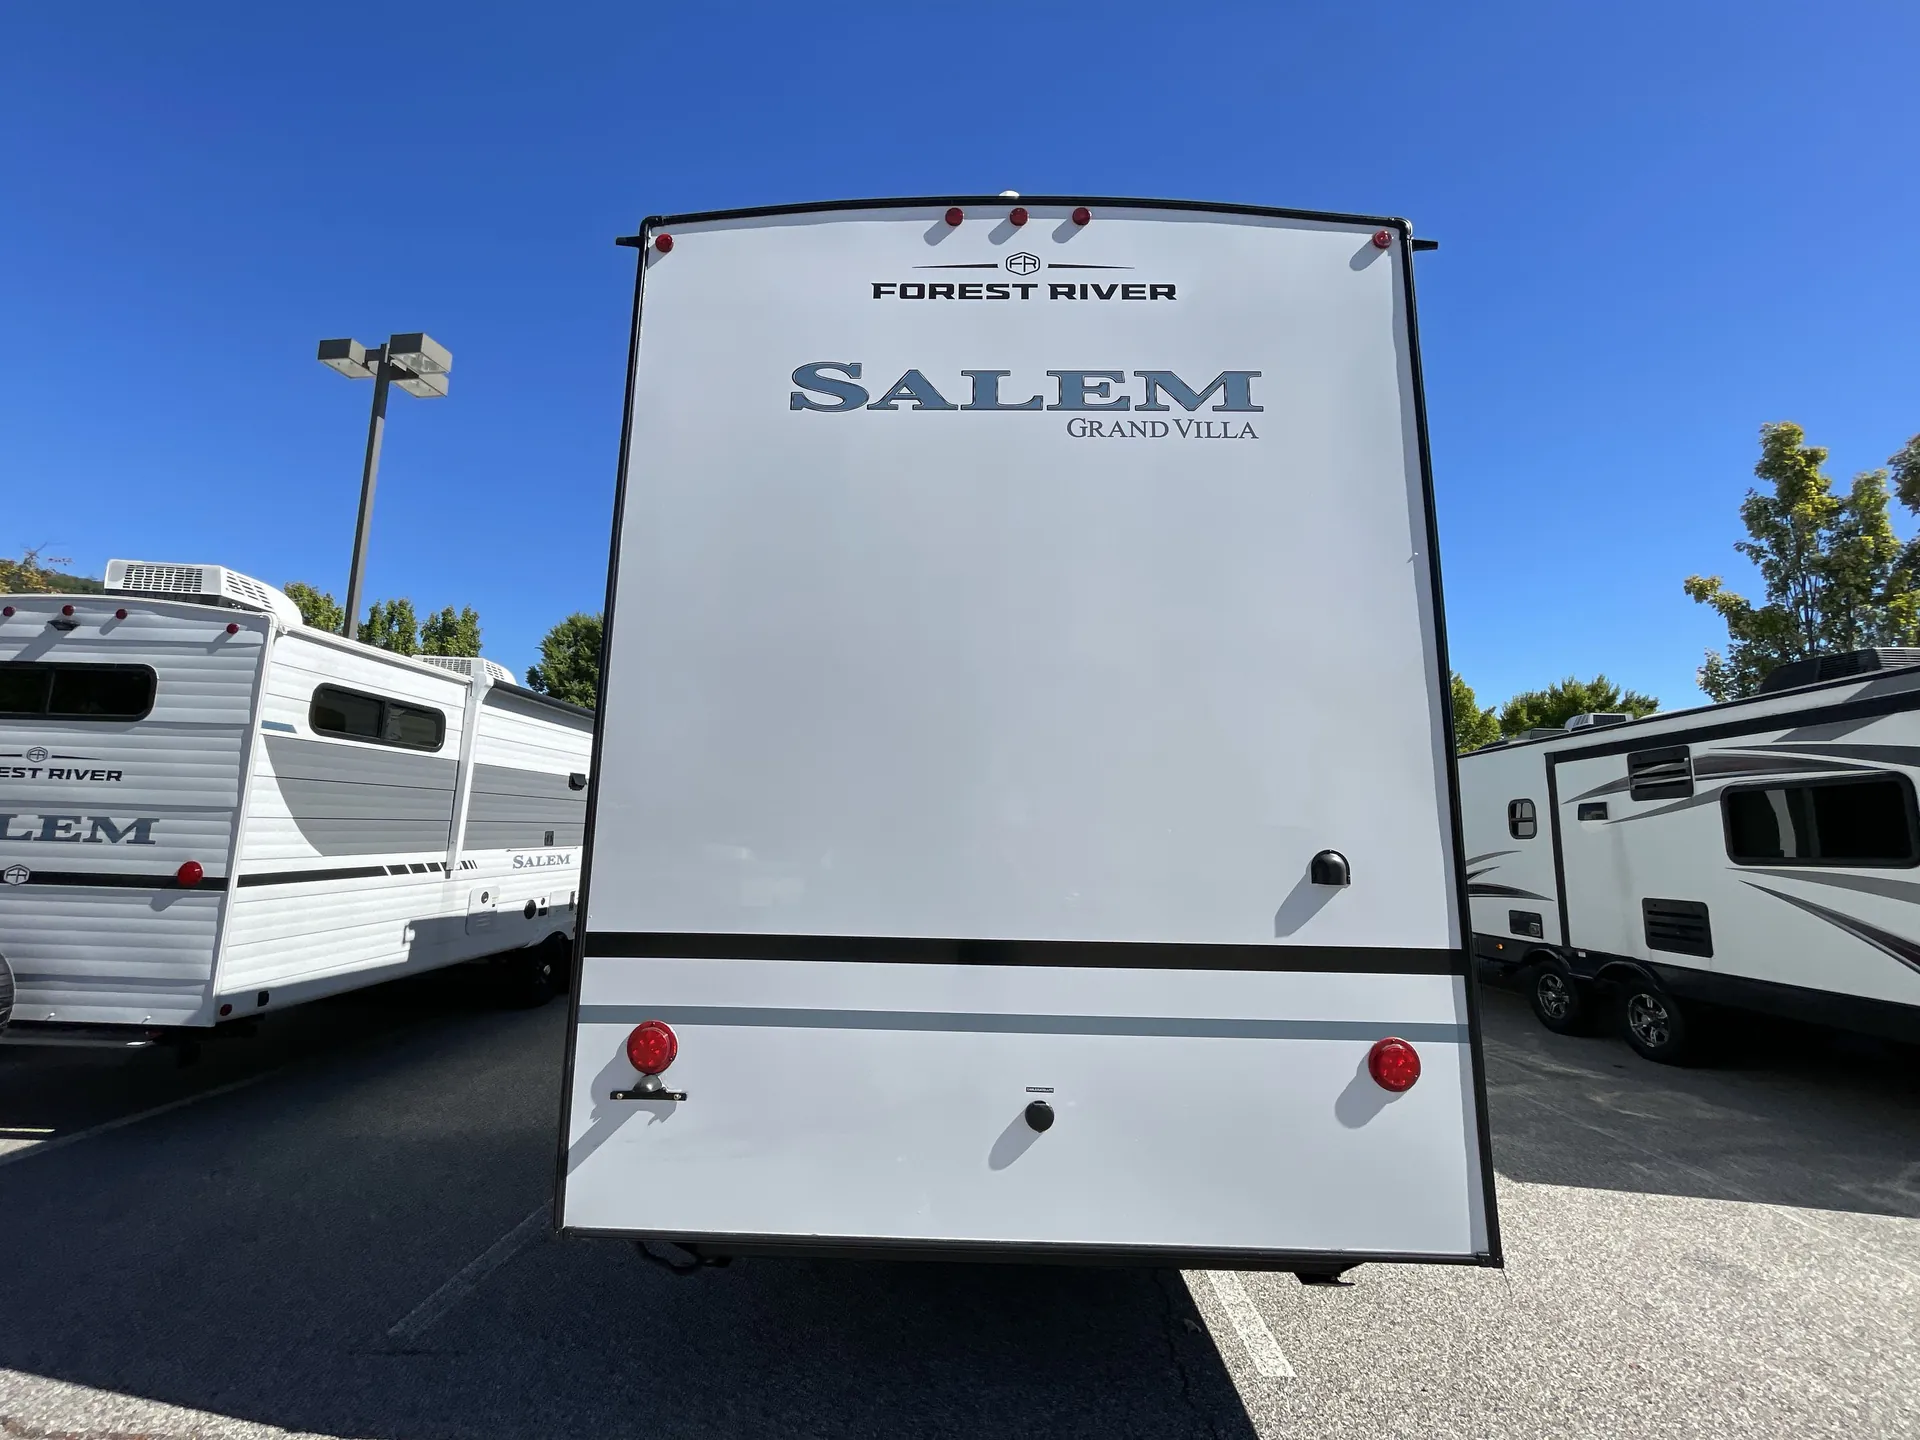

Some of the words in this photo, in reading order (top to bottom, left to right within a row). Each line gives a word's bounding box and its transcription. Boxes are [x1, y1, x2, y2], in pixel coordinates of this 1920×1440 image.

[871, 282, 1038, 300] FOREST
[1048, 283, 1177, 301] RIVER
[790, 361, 1264, 412] SALEM
[1066, 417, 1169, 438] GRAND
[1172, 418, 1259, 439] VILLA
[48, 768, 122, 781] RIVER
[513, 854, 571, 869] SALEM
